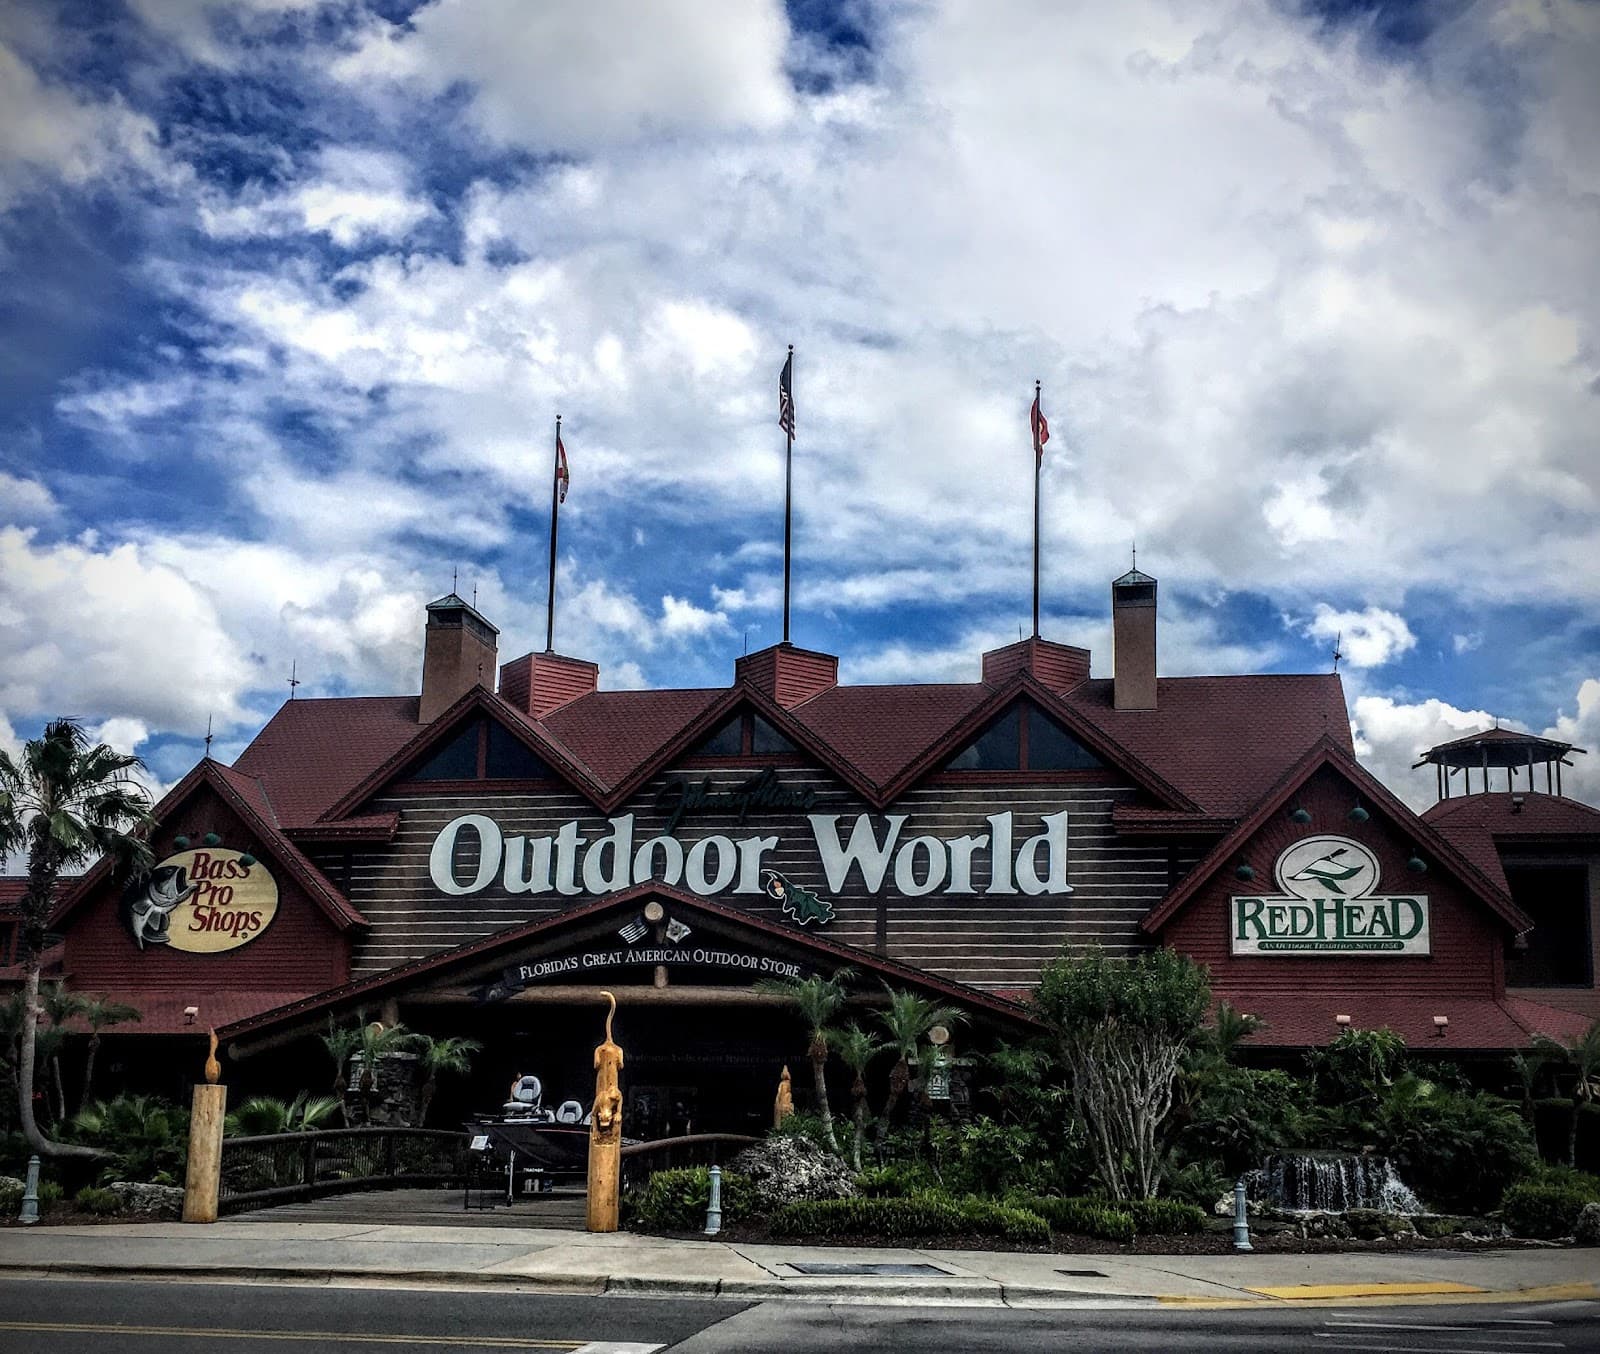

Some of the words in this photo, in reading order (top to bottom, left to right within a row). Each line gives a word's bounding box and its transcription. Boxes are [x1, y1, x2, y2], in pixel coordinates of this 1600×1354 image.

[188, 852, 251, 880] Bass
[429, 812, 779, 896] Outdoor
[807, 810, 1074, 897] World
[189, 880, 234, 906] Pro
[188, 904, 263, 938] Shops
[1235, 898, 1424, 940] REDHEAD
[519, 956, 579, 980] FLORIDA'S
[582, 951, 623, 966] GREAT
[624, 949, 690, 963] AMERICAN
[693, 949, 758, 969] OUTDOOR
[759, 957, 801, 978] STORE
